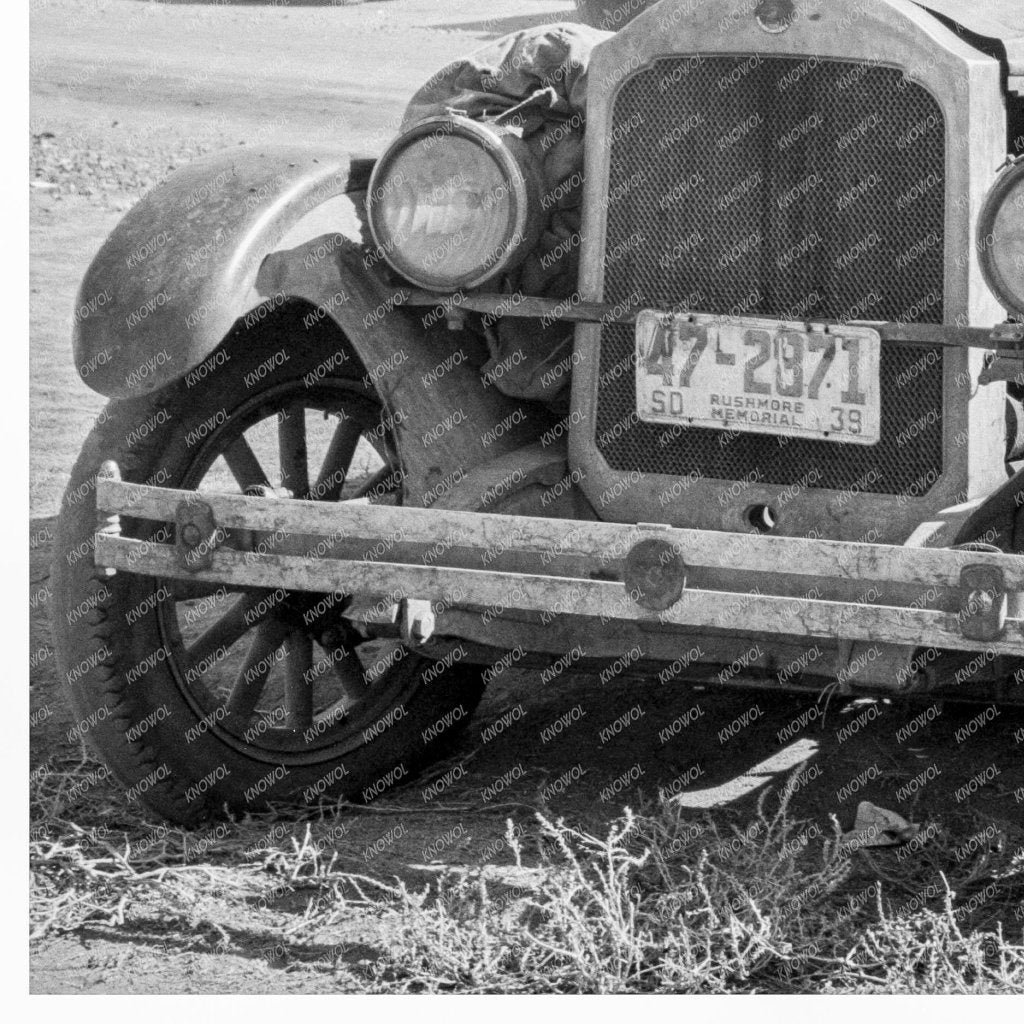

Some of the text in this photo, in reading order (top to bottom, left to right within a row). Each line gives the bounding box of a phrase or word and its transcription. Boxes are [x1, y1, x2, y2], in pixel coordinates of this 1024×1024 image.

[651, 390, 683, 415] SD
[710, 393, 805, 414] RUSHMORE
[710, 408, 801, 427] MEMORIAL
